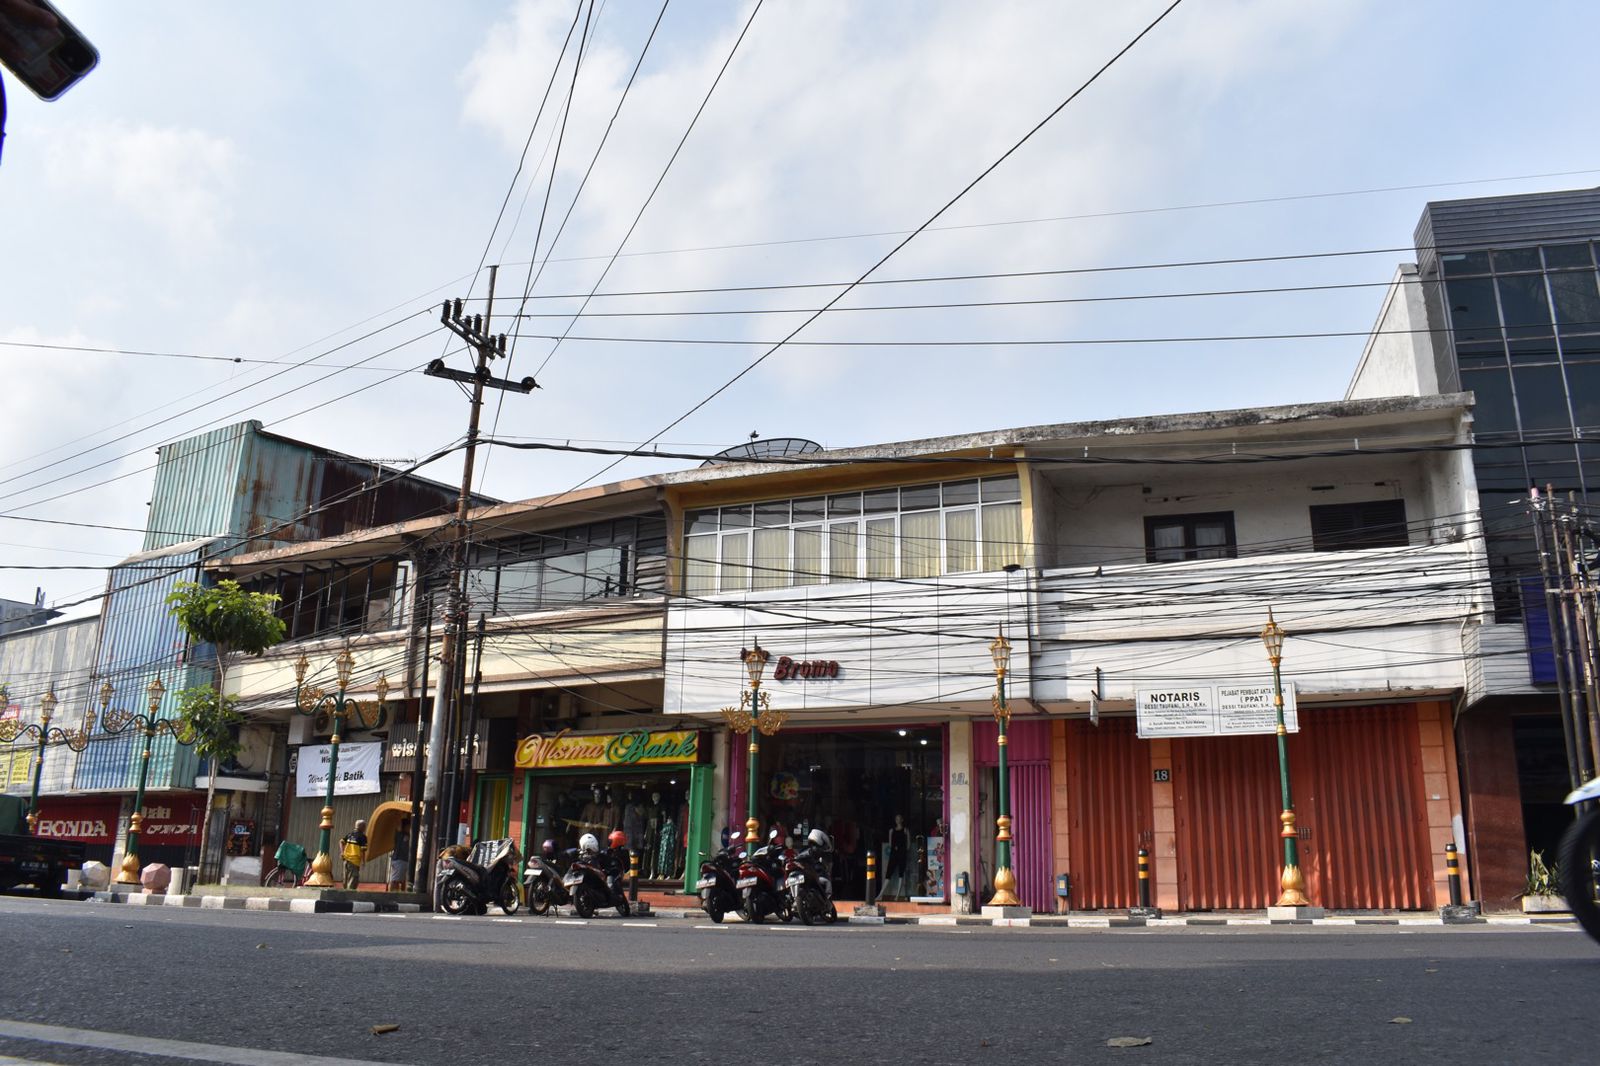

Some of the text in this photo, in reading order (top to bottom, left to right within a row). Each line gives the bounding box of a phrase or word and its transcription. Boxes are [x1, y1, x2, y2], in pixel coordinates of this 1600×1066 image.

[774, 656, 839, 680] Bromo
[1150, 692, 1200, 703] NOTARIS
[515, 728, 603, 765] Wisma
[605, 729, 697, 764] Batik
[343, 770, 365, 782] Batik
[1155, 770, 1168, 781] 18
